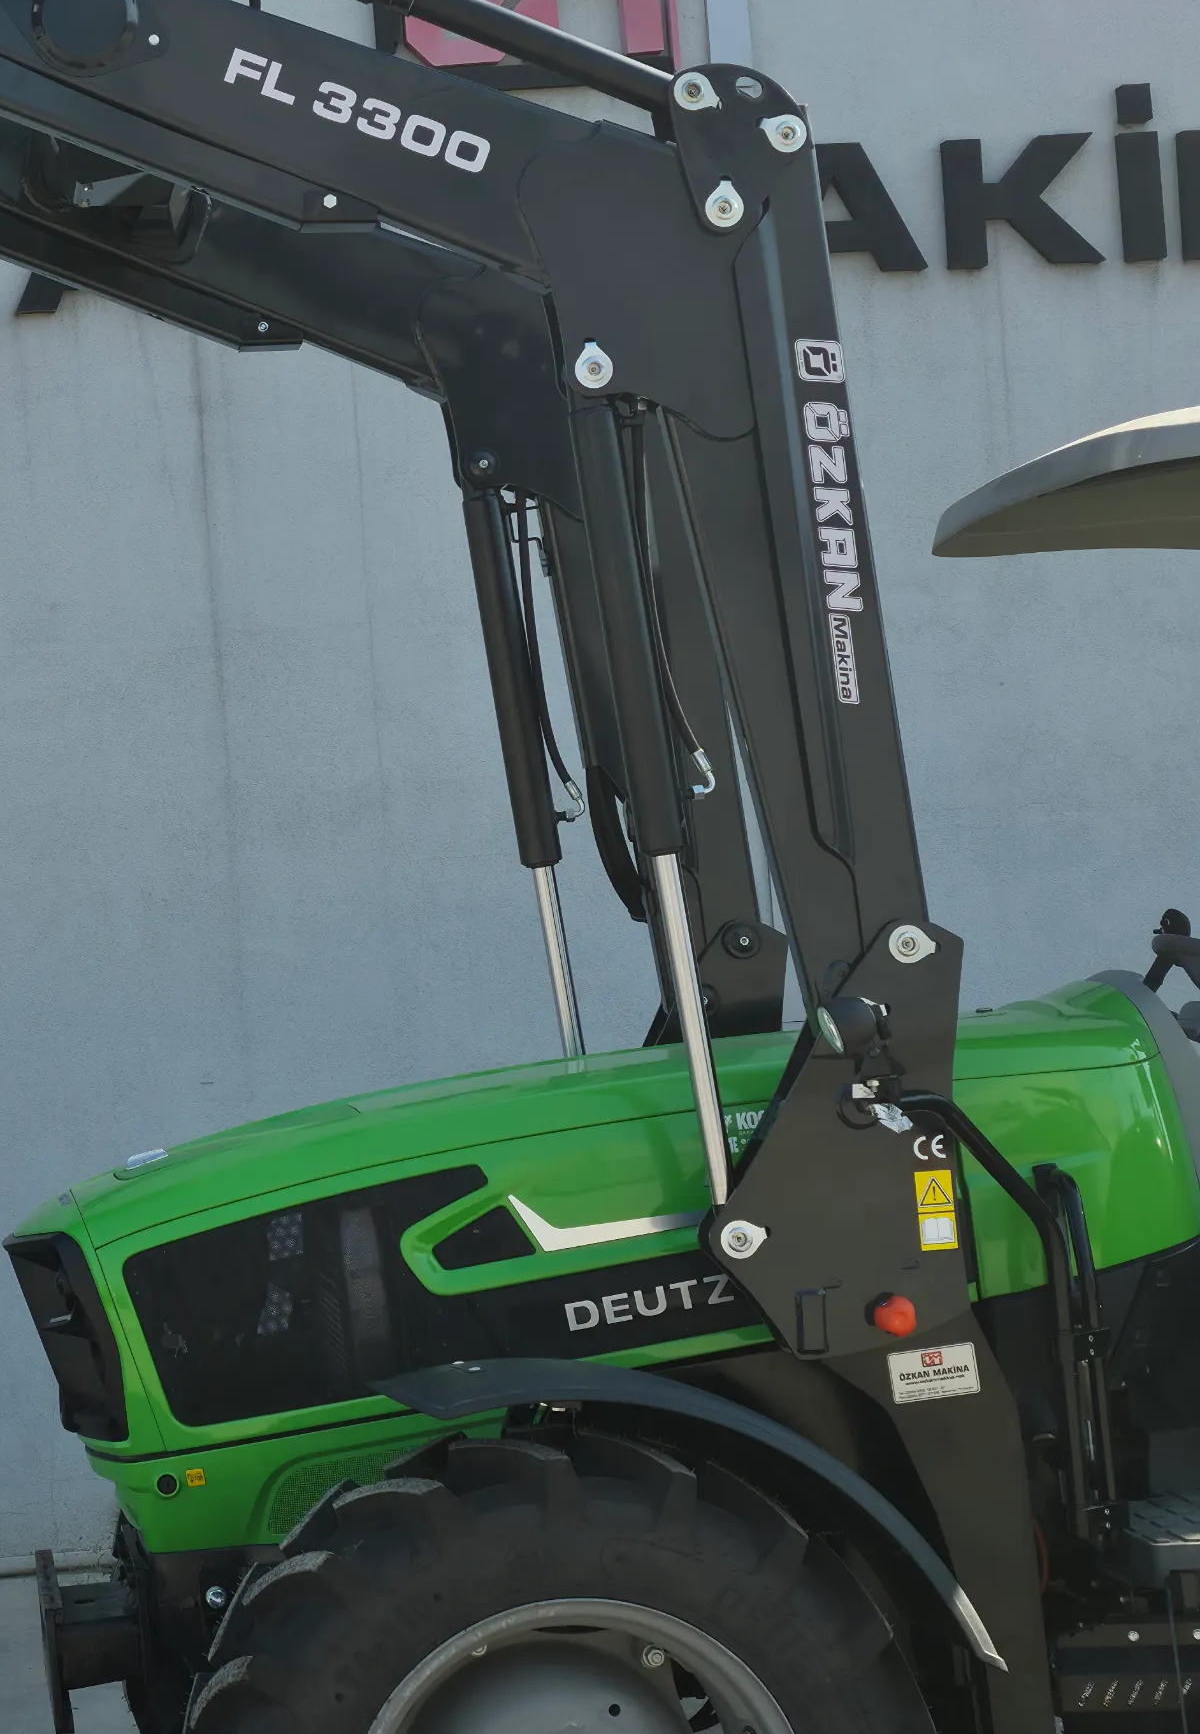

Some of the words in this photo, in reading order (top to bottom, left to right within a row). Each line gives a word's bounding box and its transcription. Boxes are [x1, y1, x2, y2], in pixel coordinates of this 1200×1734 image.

[224, 48, 295, 105] FL
[312, 81, 490, 172] 3300
[803, 401, 863, 611] ÖZKAN
[832, 616, 853, 700] Makina
[913, 1134, 946, 1160] CE
[564, 1273, 735, 1332] DEUTZ
[899, 1370, 931, 1382] ÖZKAN
[933, 1364, 970, 1376] MAKİNA
